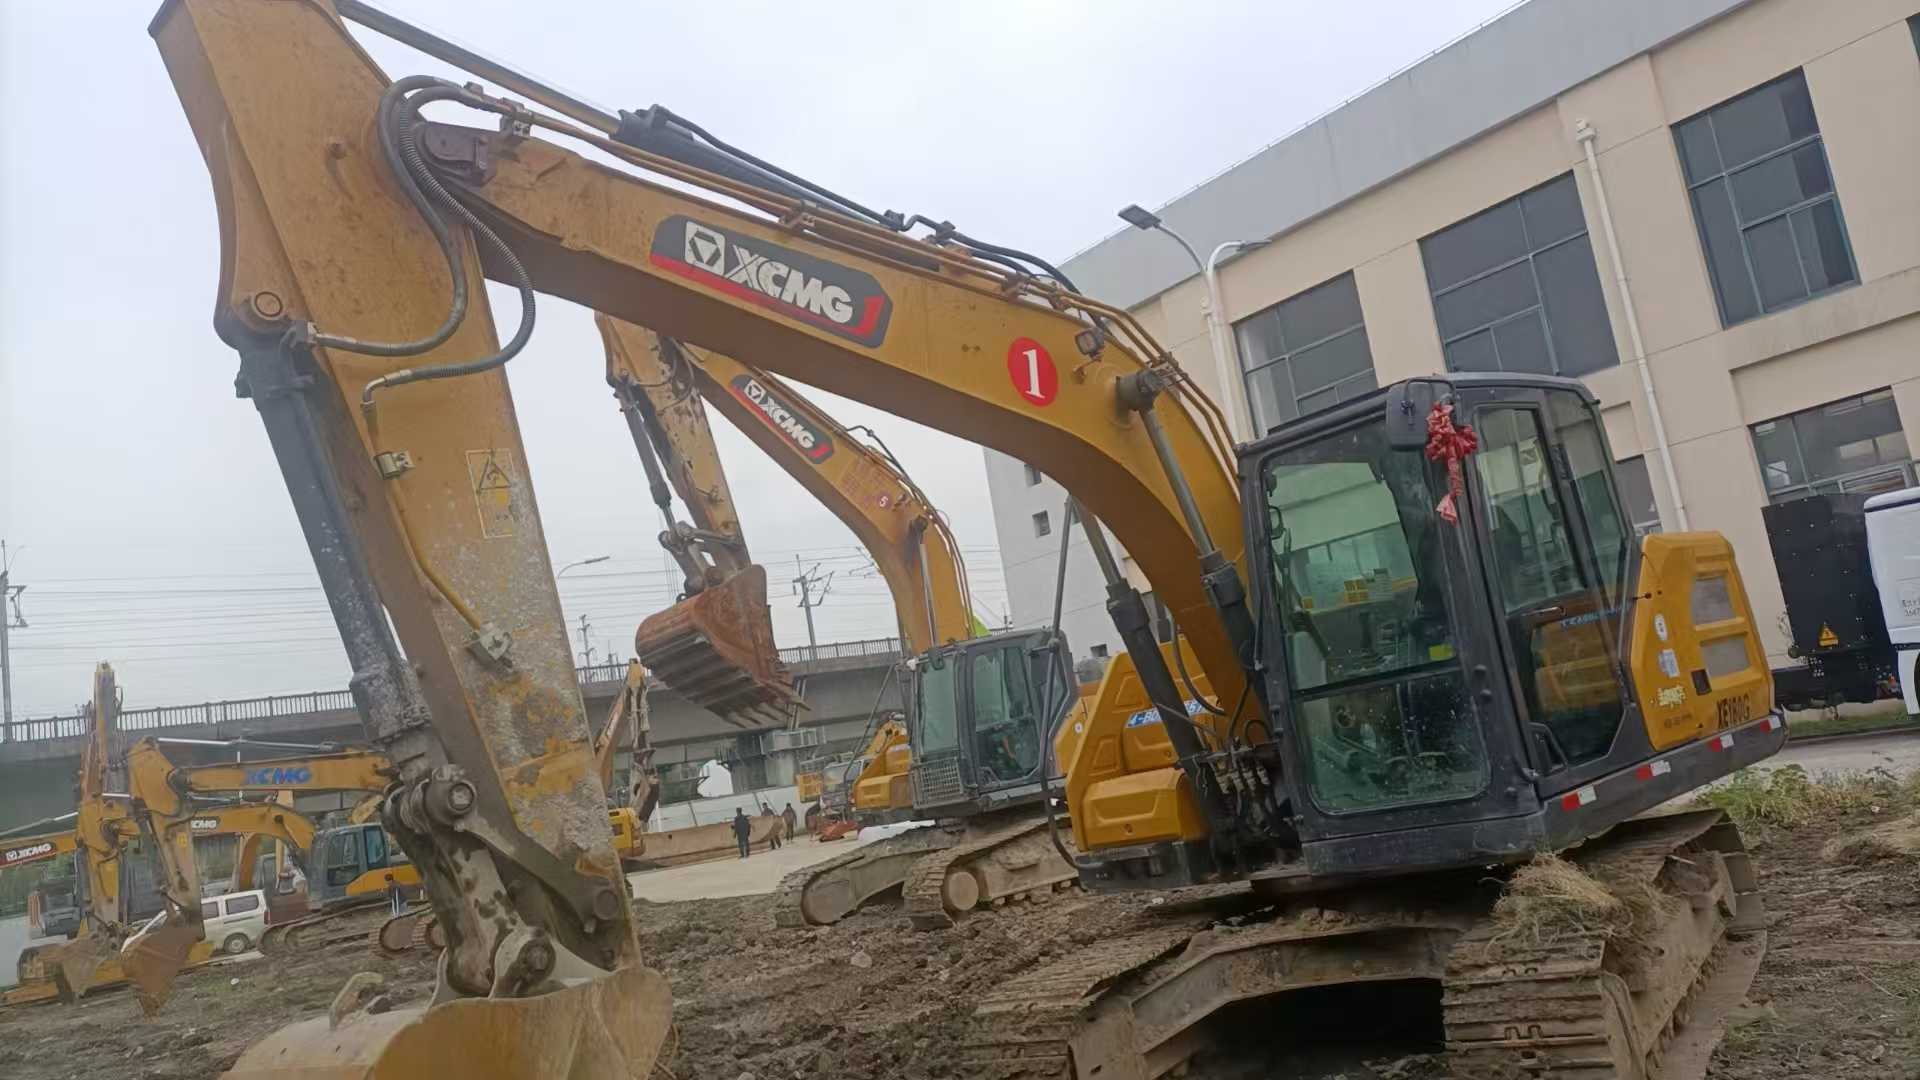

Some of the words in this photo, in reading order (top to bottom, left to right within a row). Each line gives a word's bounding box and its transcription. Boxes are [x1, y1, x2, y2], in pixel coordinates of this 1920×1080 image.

[725, 244, 853, 324] XCMG
[1022, 348, 1046, 399] 1
[759, 396, 816, 449] XCMG
[245, 766, 312, 785] XCMG
[17, 842, 52, 859] XCMG
